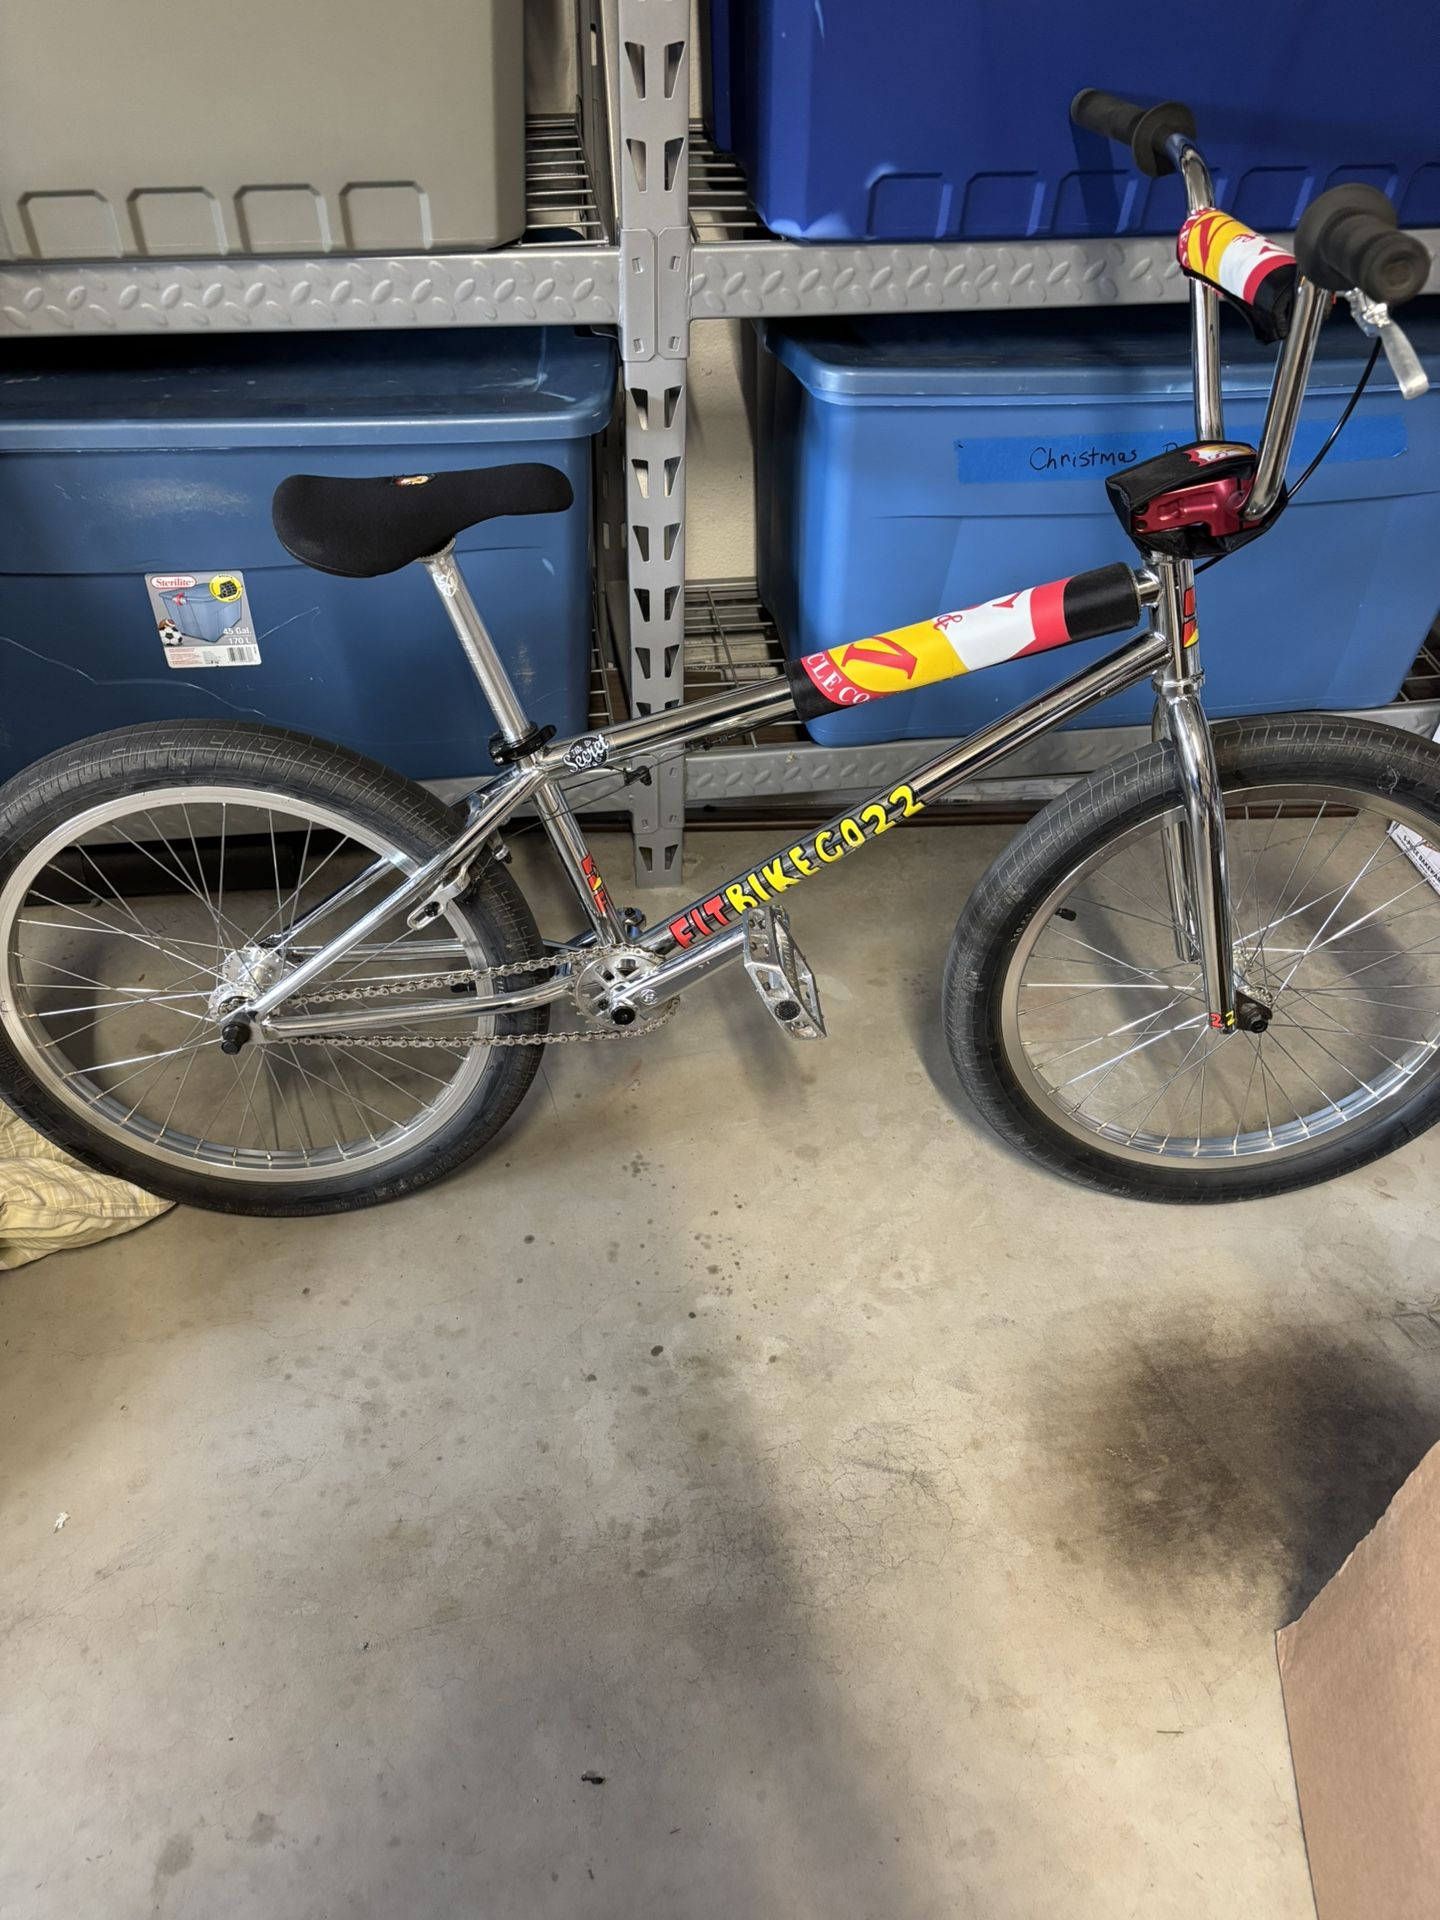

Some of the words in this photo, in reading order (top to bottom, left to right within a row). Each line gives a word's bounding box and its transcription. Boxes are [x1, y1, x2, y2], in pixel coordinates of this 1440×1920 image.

[1029, 447, 1137, 471] Christmas
[156, 578, 191, 587] Sterilite
[223, 627, 234, 635] 45
[229, 637, 244, 645] 170
[562, 733, 609, 773] Secret
